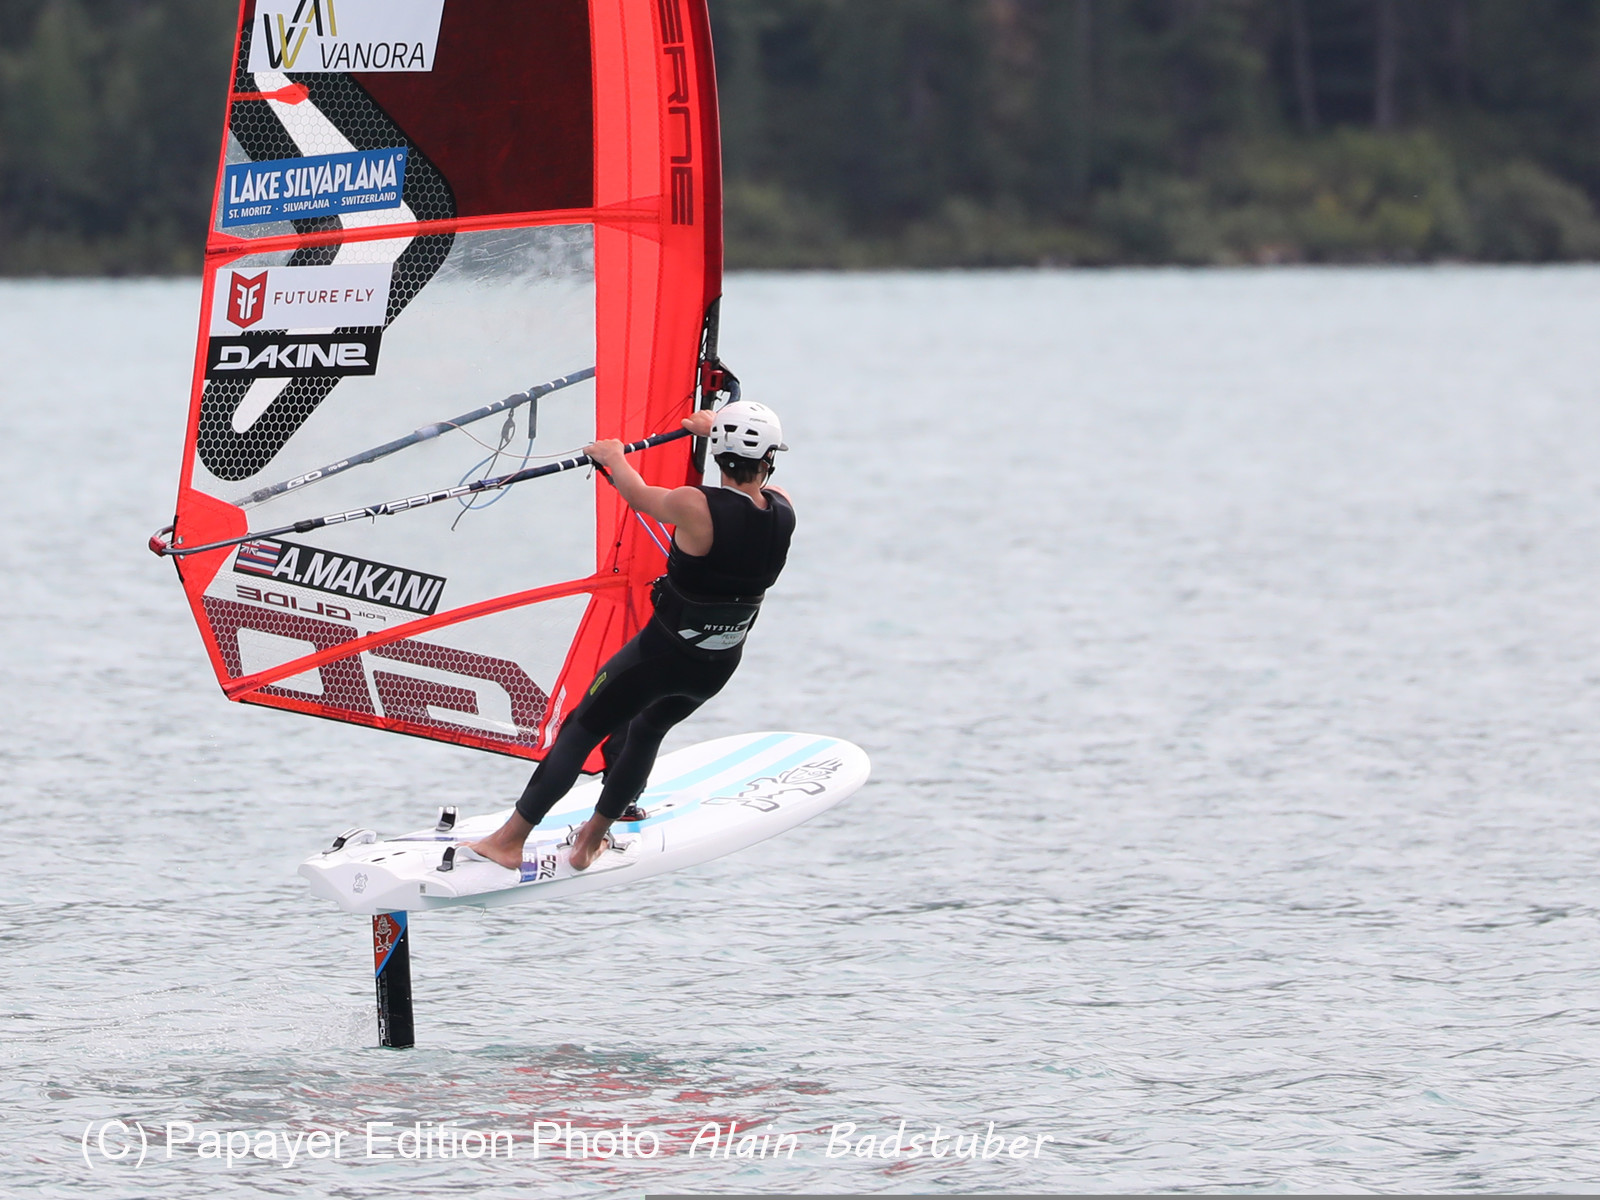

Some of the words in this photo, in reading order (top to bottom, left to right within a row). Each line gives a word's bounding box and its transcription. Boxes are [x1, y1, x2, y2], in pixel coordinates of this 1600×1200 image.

[320, 42, 425, 69] VANORA
[229, 168, 282, 204] LAKE
[283, 154, 398, 199] SILVAPLANA
[228, 209, 240, 219] ST.
[241, 204, 272, 218] MORITZ
[282, 198, 330, 213] SILVAPLANA
[340, 191, 397, 207] SWITZERLAND
[273, 290, 339, 305] FUTURE
[344, 288, 375, 302] FLY
[323, 484, 471, 526] SEVERNE
[272, 546, 443, 612] A.MAKANI
[703, 623, 741, 631] MYSTIC
